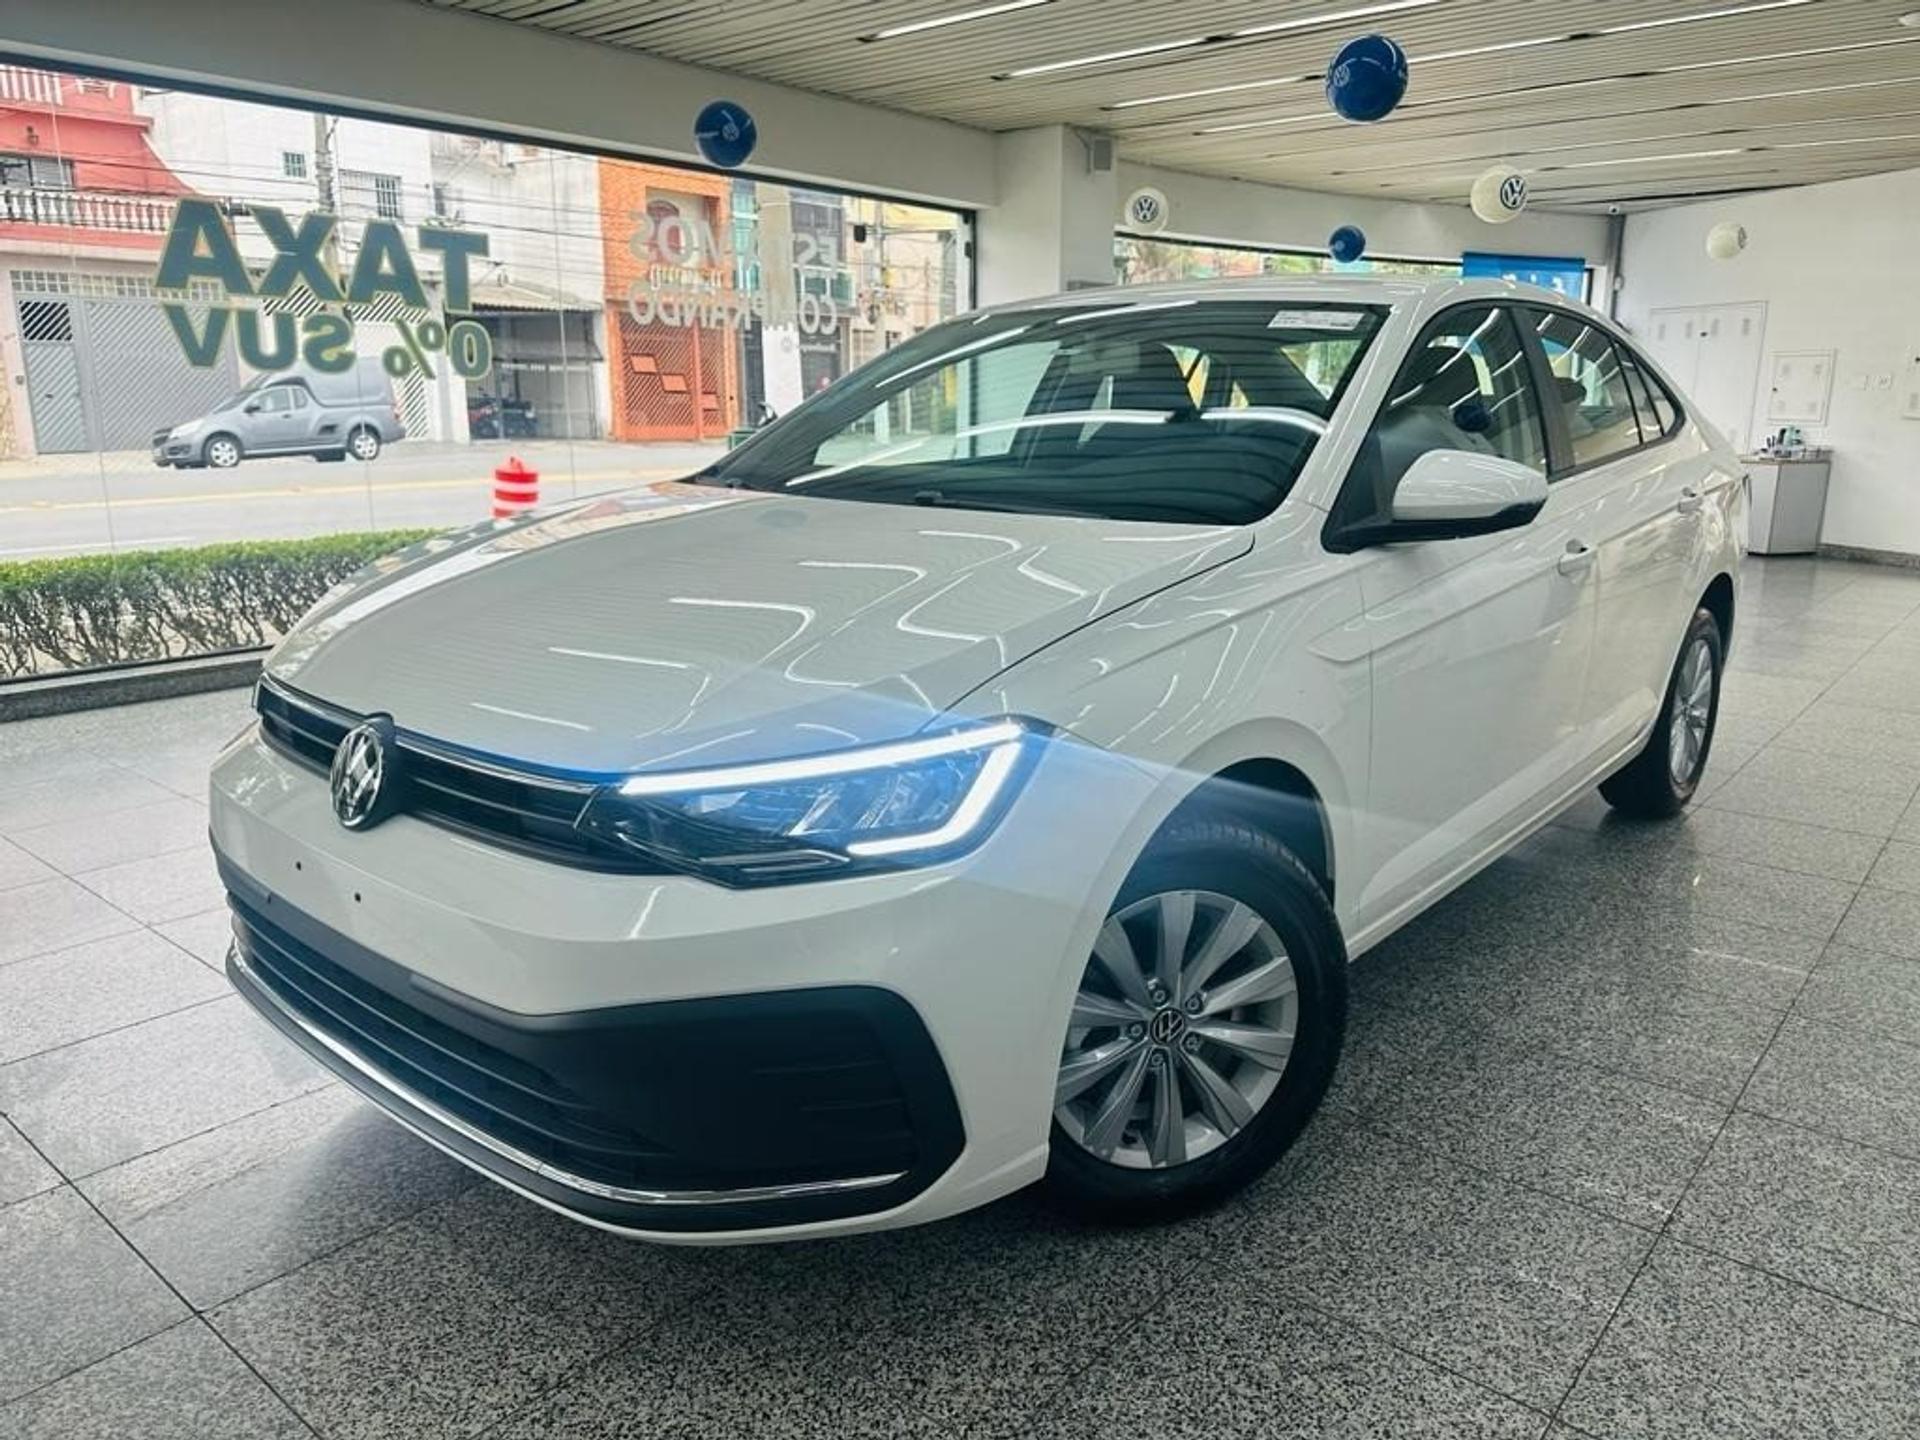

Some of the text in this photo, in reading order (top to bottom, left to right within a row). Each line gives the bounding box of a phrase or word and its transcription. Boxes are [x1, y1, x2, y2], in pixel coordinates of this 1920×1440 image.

[1132, 195, 1159, 223] VW
[1500, 175, 1526, 210] VW
[1151, 1008, 1185, 1045] VW
